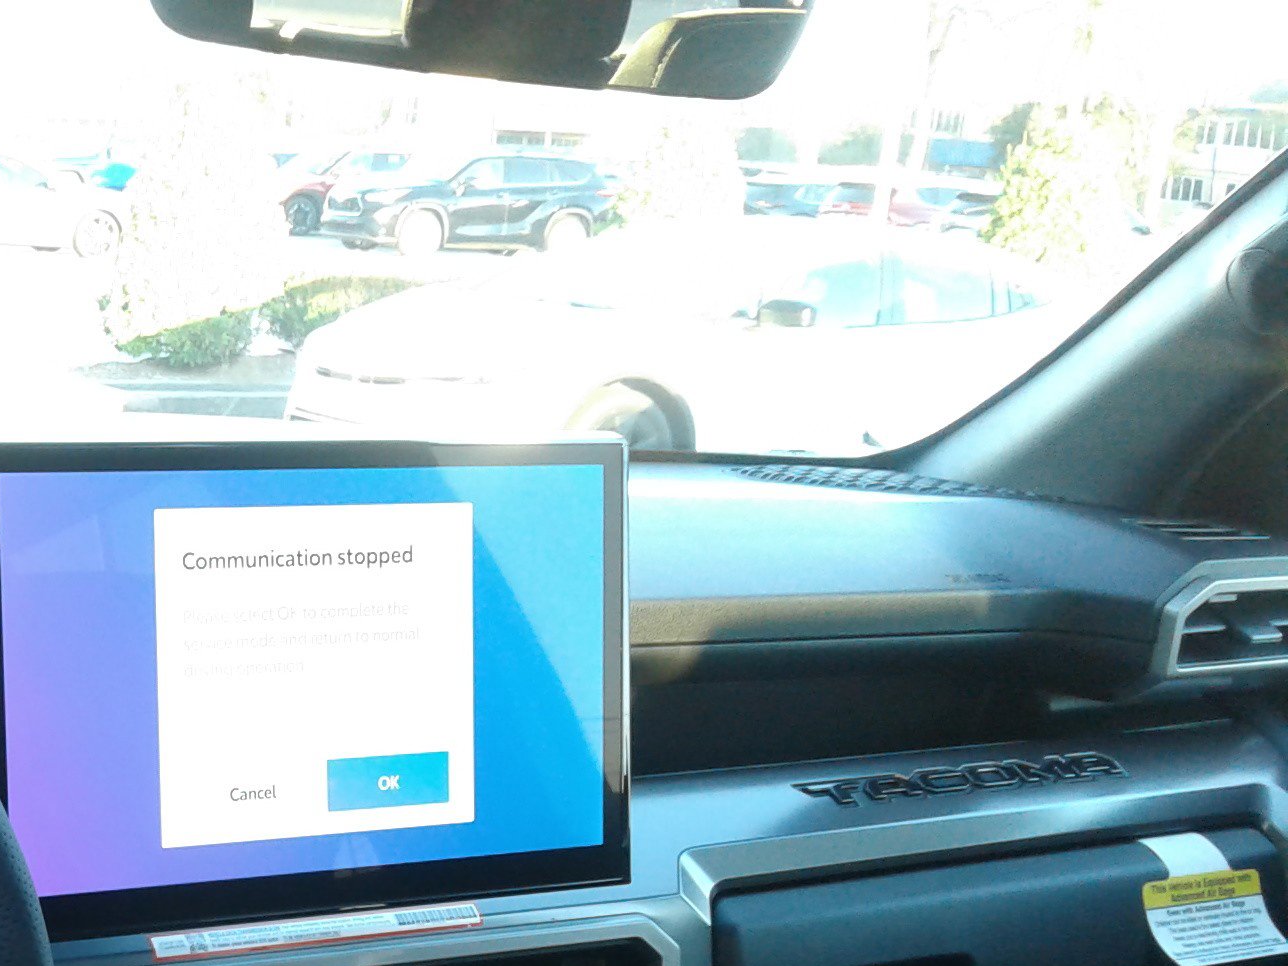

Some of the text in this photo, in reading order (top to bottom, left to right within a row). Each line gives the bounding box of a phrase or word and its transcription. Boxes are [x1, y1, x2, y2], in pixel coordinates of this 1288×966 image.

[182, 545, 413, 571] Communication stopped
[303, 606, 317, 619] to
[320, 602, 385, 622] complete
[387, 600, 409, 616] the
[311, 631, 352, 646] return
[356, 630, 369, 643] to
[372, 626, 420, 642] normal
[377, 774, 401, 791] OK
[791, 751, 1129, 808] TACOMA
[229, 784, 277, 802] Cancel
